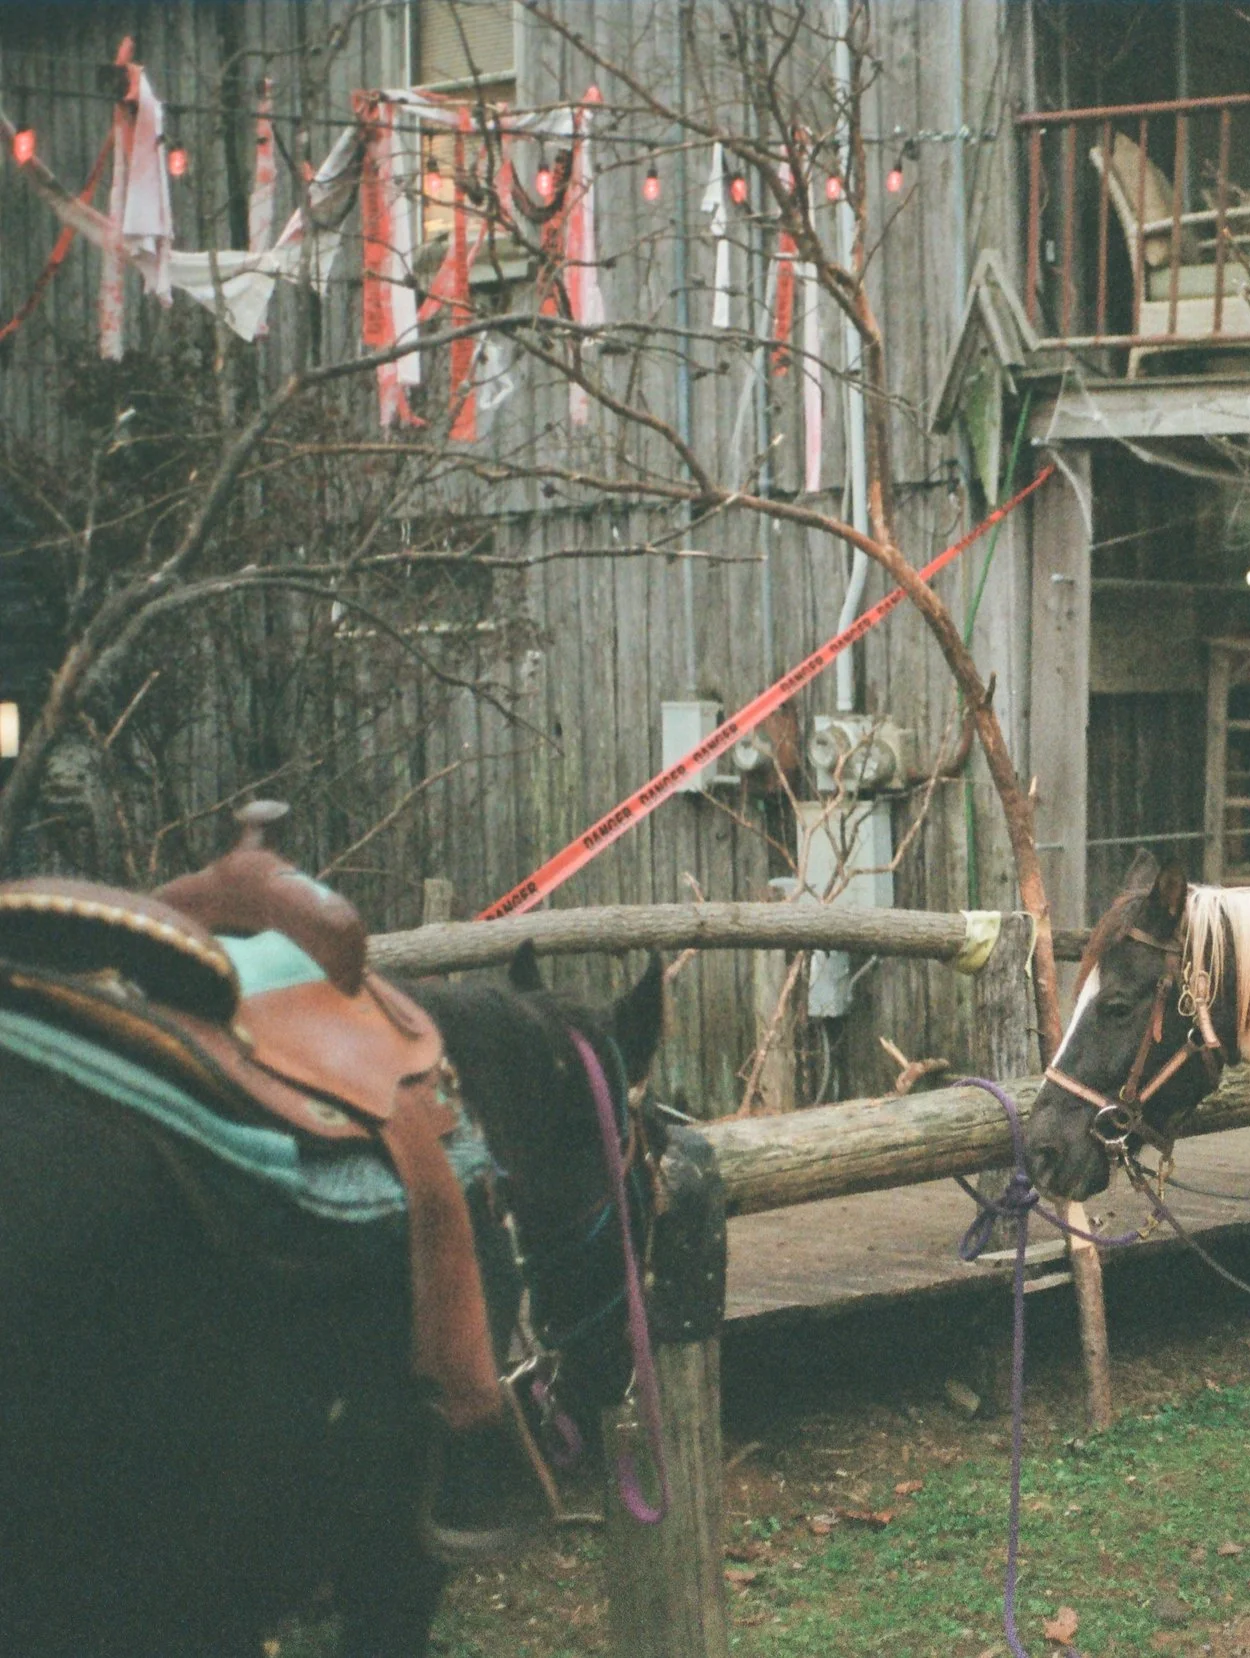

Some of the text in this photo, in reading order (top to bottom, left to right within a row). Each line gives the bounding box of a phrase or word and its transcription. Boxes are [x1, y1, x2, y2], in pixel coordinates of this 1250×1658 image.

[583, 806, 633, 850] DANGER
[639, 764, 686, 805] DANGER
[692, 723, 738, 763] DANGER
[779, 655, 824, 693] DANGER
[829, 617, 871, 653] DANGER
